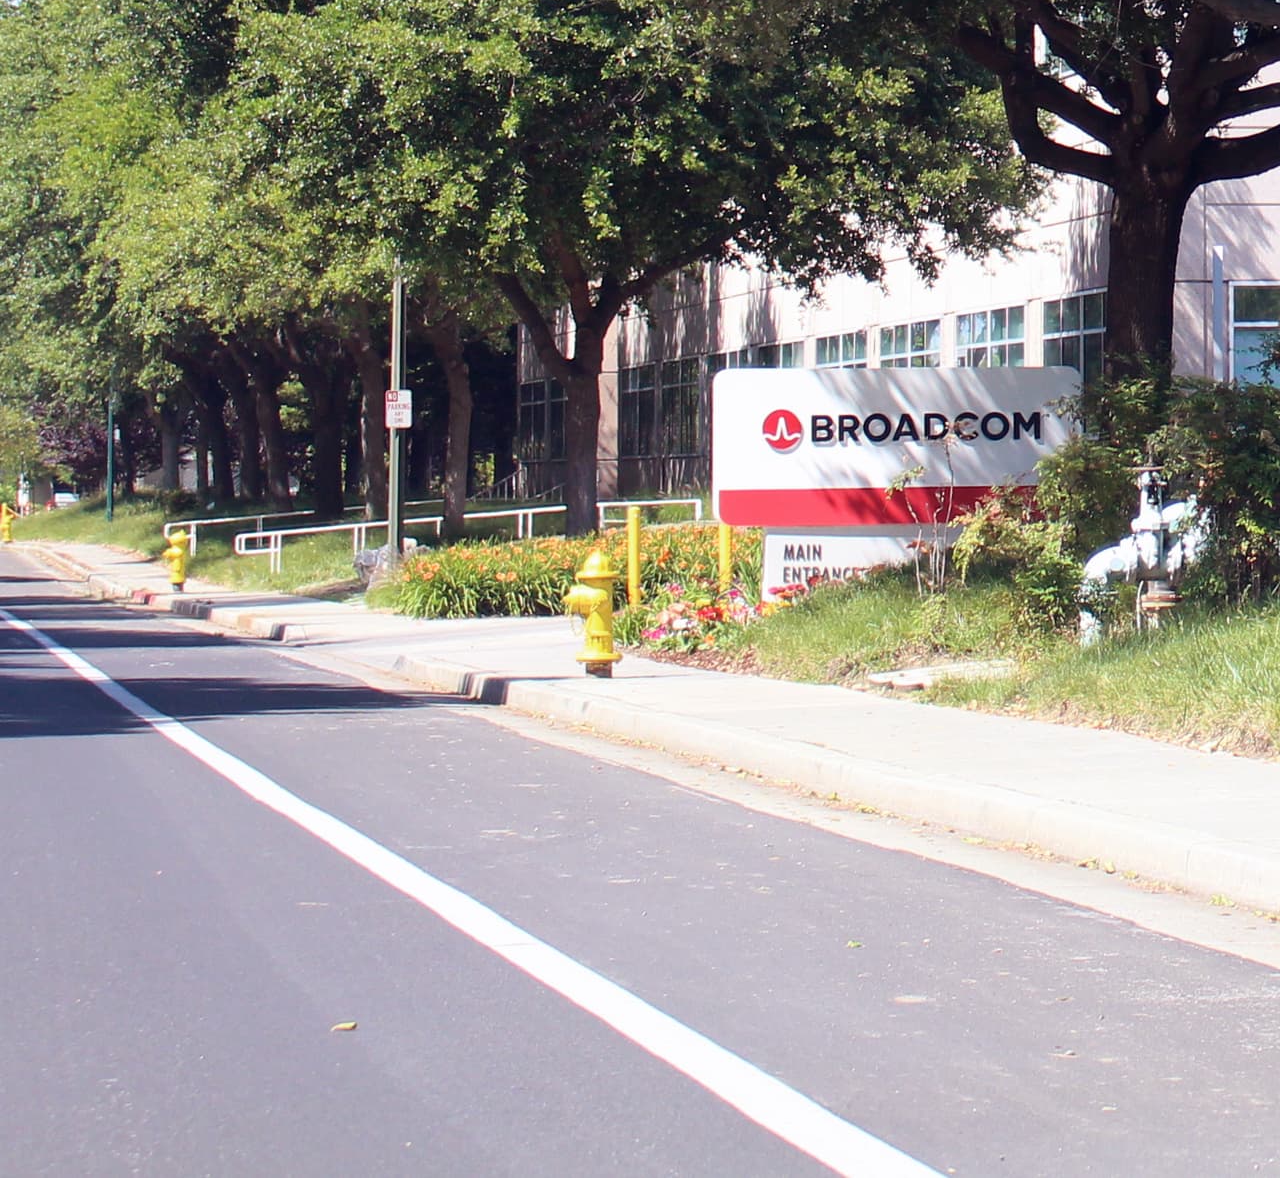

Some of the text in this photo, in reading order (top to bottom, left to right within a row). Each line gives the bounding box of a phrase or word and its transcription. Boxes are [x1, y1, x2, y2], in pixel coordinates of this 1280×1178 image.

[387, 391, 398, 402] NO
[810, 411, 1041, 443] BROADCOM
[783, 544, 822, 562] MAIN
